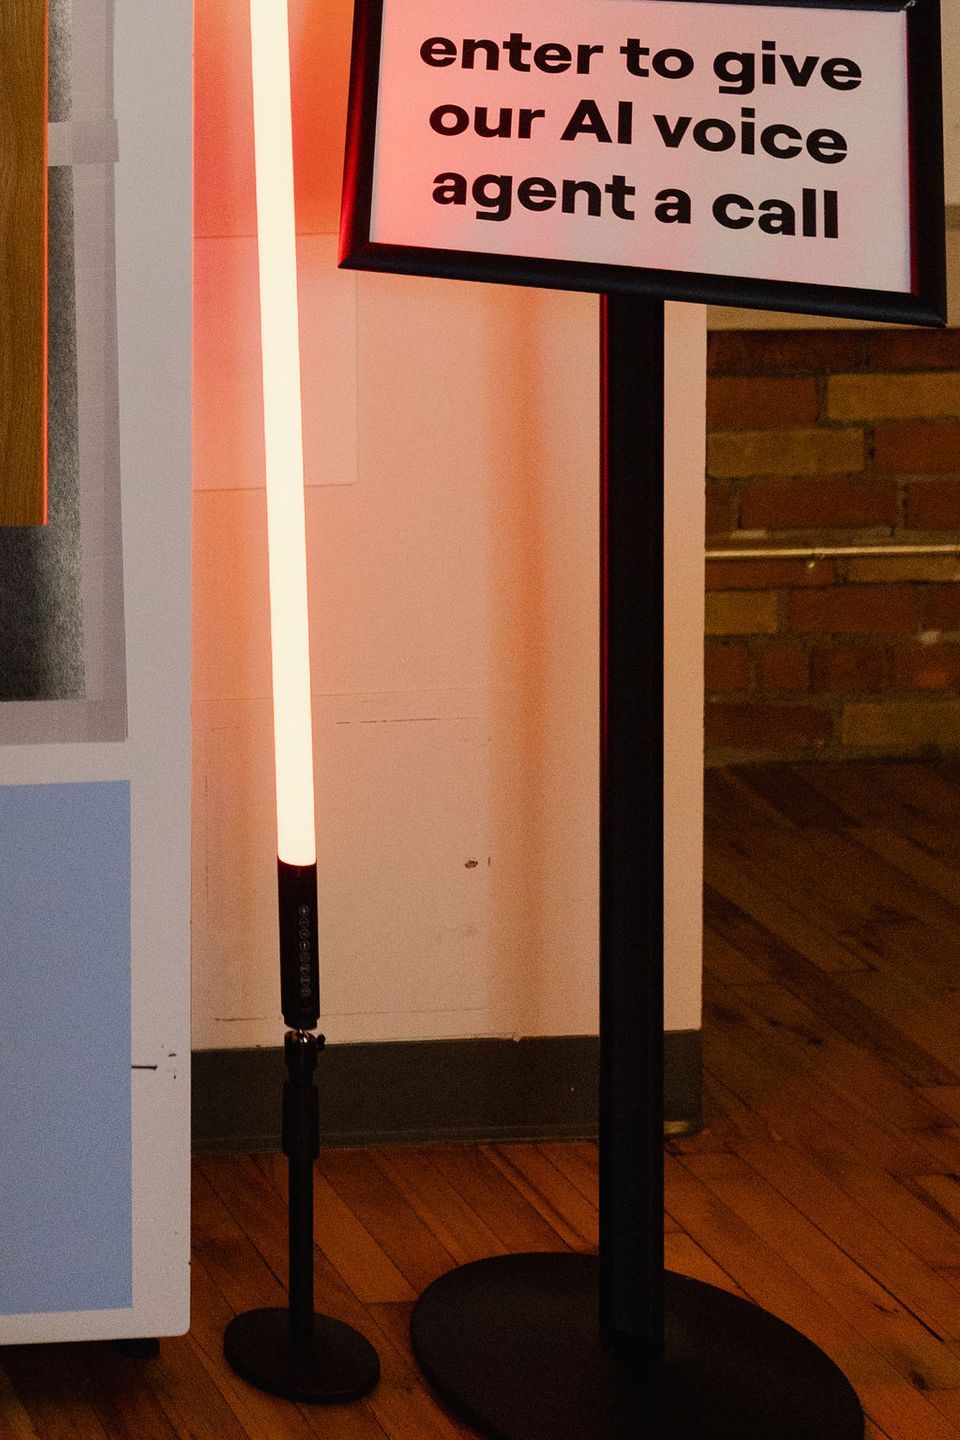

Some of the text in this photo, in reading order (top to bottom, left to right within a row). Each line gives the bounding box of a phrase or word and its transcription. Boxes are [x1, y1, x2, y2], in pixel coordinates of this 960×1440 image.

[420, 32, 862, 94] enter to give
[429, 99, 848, 164] our AI voice
[432, 171, 839, 239] agent a call
